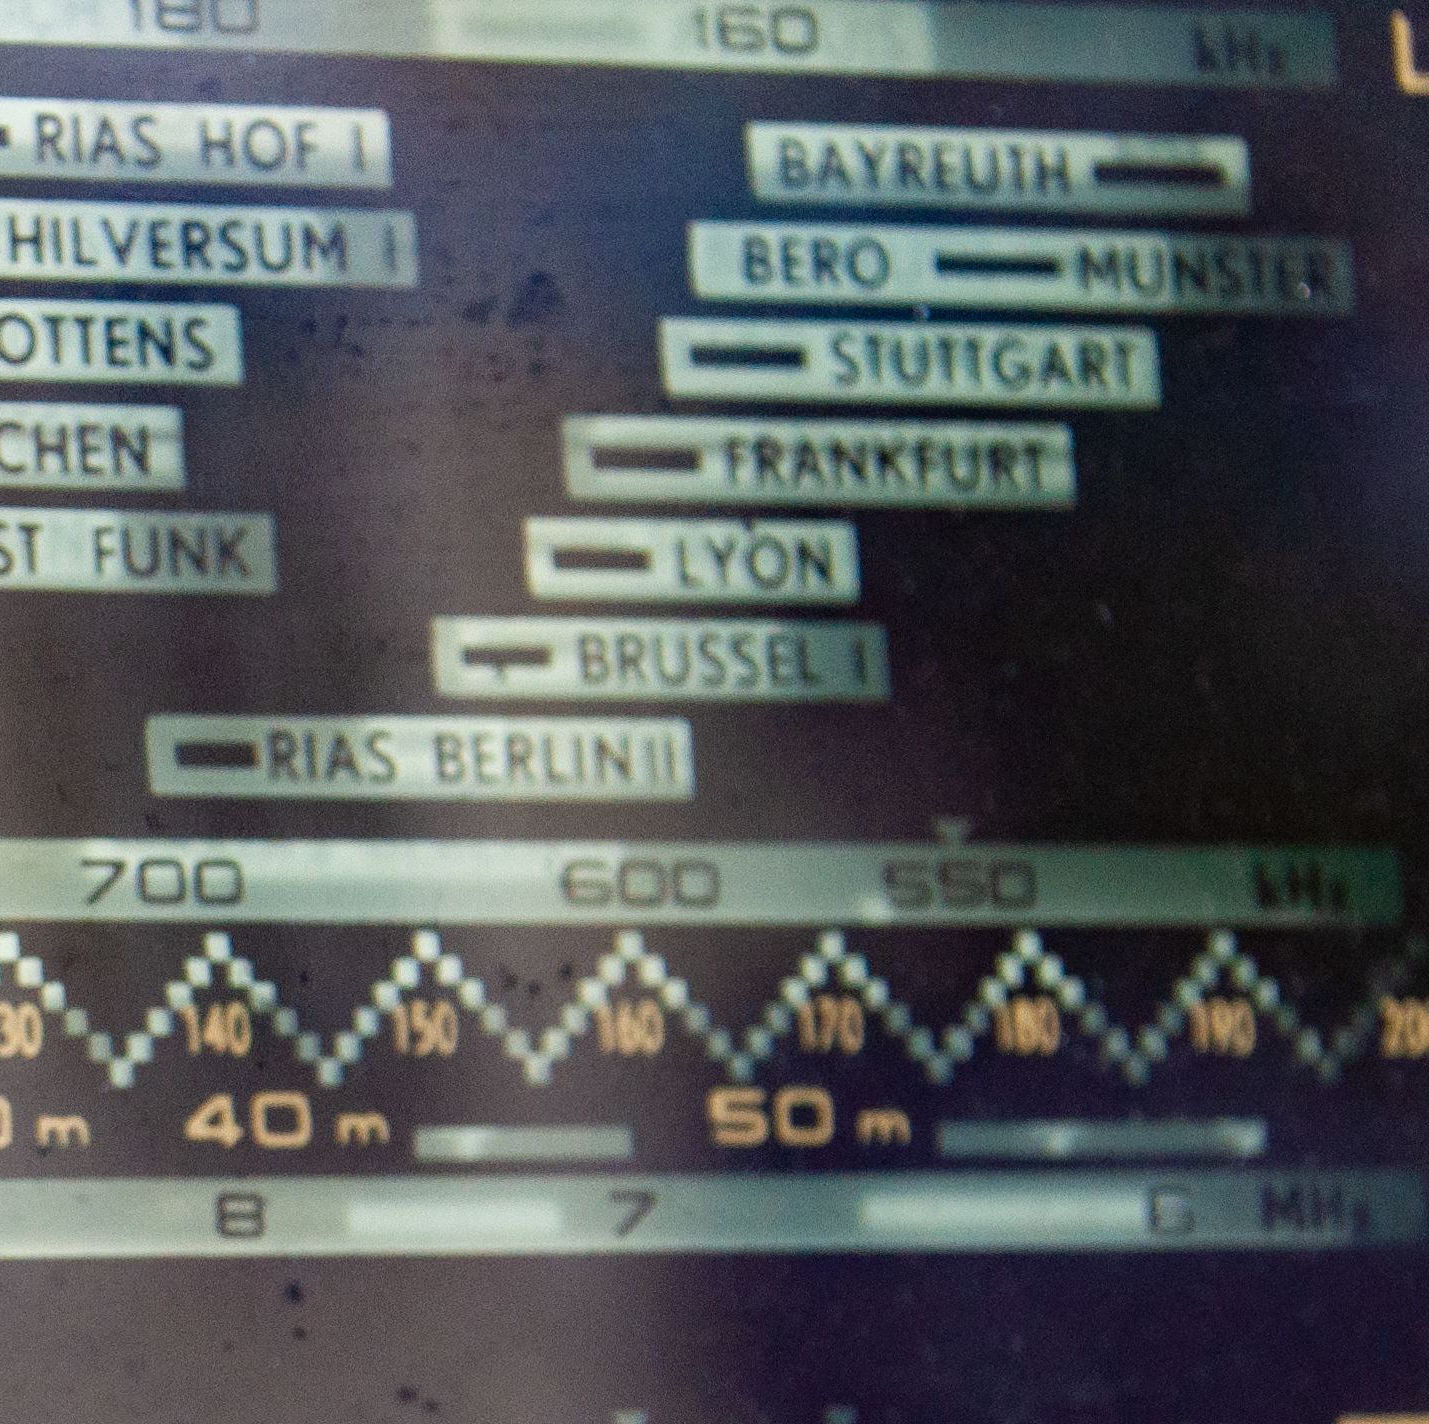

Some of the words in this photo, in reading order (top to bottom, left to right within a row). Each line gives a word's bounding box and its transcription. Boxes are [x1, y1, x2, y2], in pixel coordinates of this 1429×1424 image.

[698, 7, 818, 54] 160
[36, 113, 163, 168] RIAS
[199, 110, 319, 172] HOF
[778, 139, 1071, 194] BAYREUTH
[6, 215, 344, 273] HILVERSUM
[742, 237, 889, 289] BERO
[827, 334, 1137, 391] STUTTGART
[719, 440, 1043, 494] FRANKFURT
[92, 528, 250, 578] FUNK
[676, 536, 835, 589] LYON
[578, 633, 819, 686] BRUSSEL
[264, 731, 398, 782] RIAS
[435, 733, 633, 783] BERLIN
[647, 741, 678, 783] II
[81, 858, 243, 904] 700
[561, 859, 721, 904] 600
[882, 859, 1039, 909] 550
[180, 1002, 252, 1055] 140
[391, 1001, 460, 1055] 150
[595, 1000, 666, 1055] 160
[798, 999, 865, 1055] 170
[993, 998, 1060, 1055] 180
[1188, 997, 1256, 1056] 190
[36, 1114, 91, 1149] m
[183, 1093, 315, 1150] 40
[336, 1111, 391, 1147] m
[707, 1086, 836, 1149] 50
[856, 1108, 912, 1147] m
[215, 1192, 266, 1240] 8
[610, 1190, 657, 1237] 7
